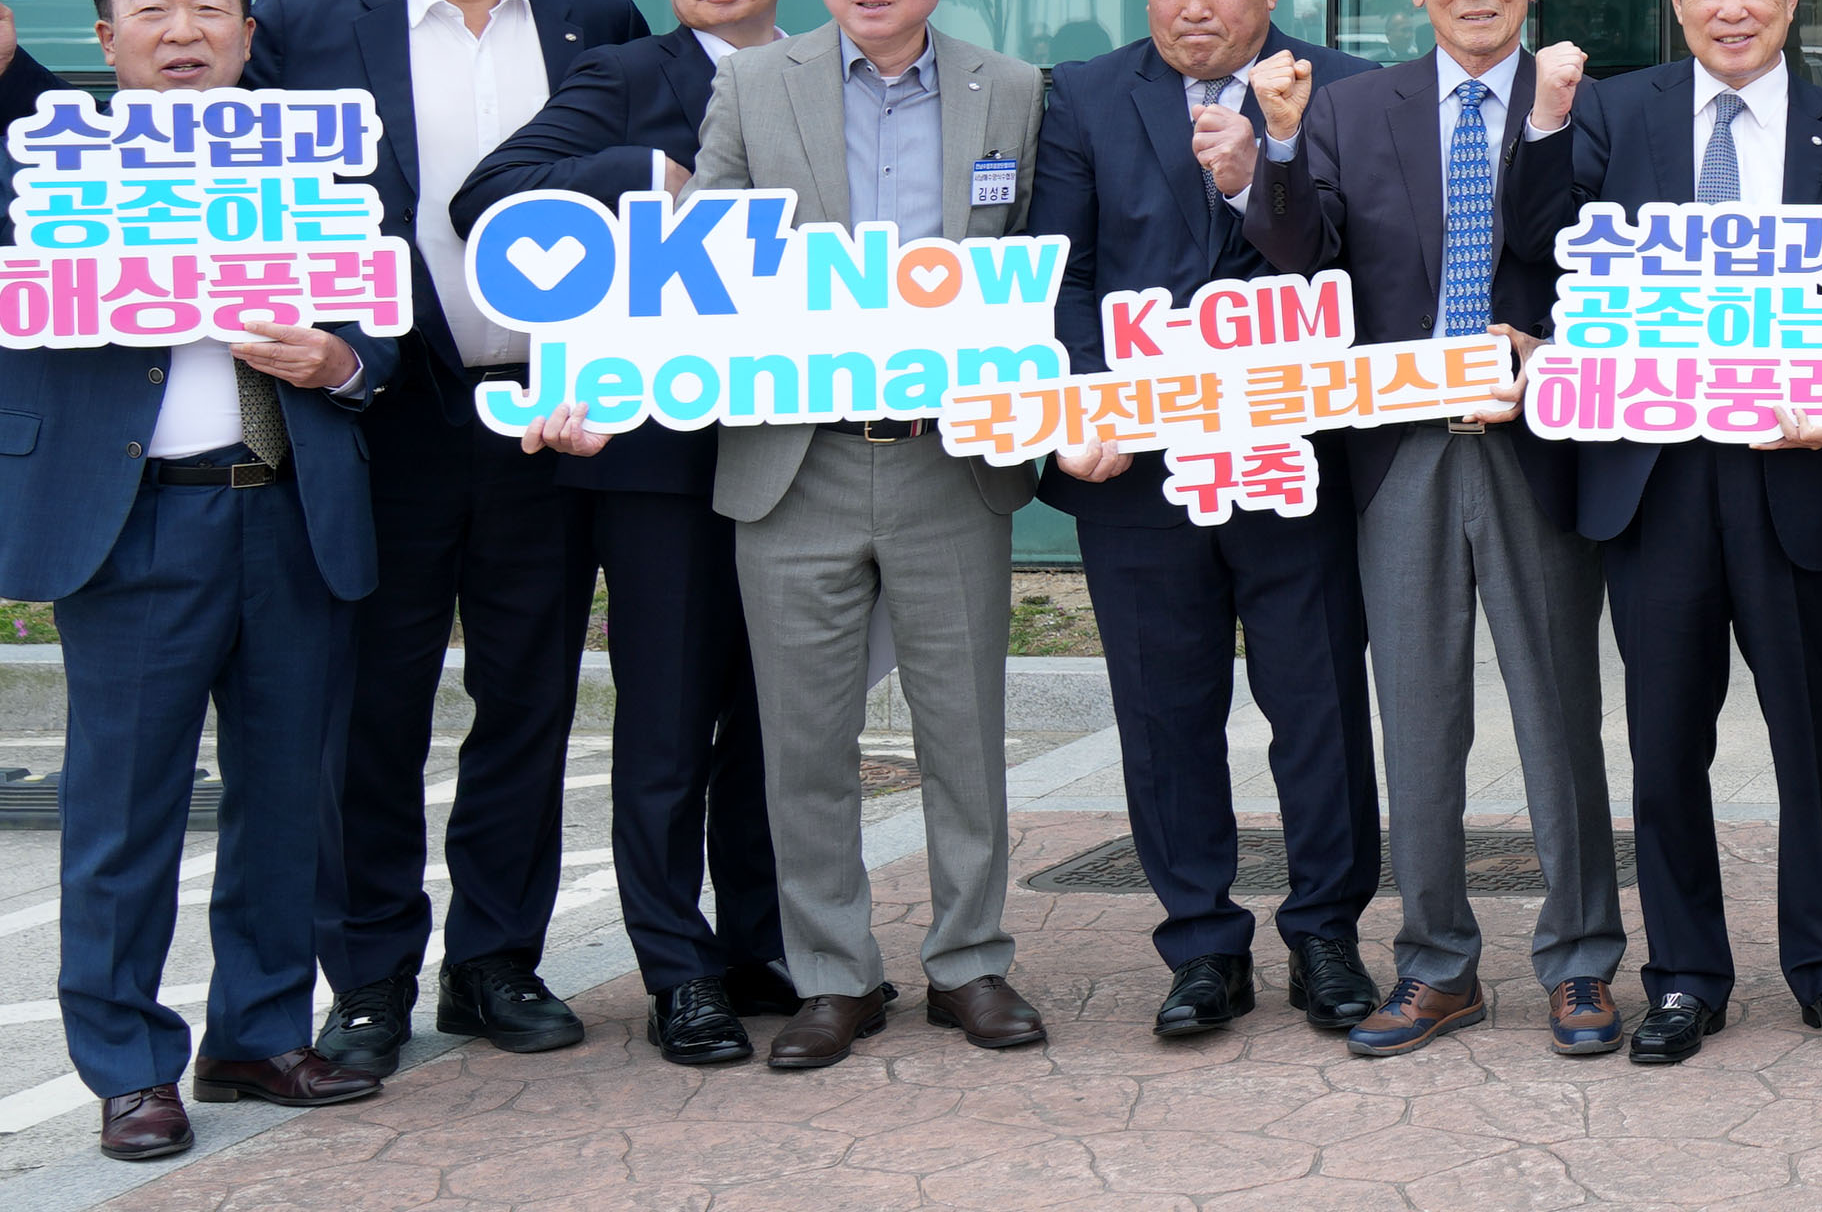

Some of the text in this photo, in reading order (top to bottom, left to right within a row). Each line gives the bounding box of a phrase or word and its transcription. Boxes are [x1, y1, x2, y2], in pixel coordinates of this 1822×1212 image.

[24, 101, 374, 172] 수산업과
[26, 176, 369, 249] 공존하는
[978, 187, 1010, 201] 김성훈
[0, 251, 400, 338] 해상풍력
[807, 228, 1060, 311] Now
[1111, 280, 1342, 360] K-GIM
[485, 341, 1060, 428] Jeonnam
[949, 342, 1501, 455] 국가전략 클러스트
[1173, 442, 1307, 513] 구축
